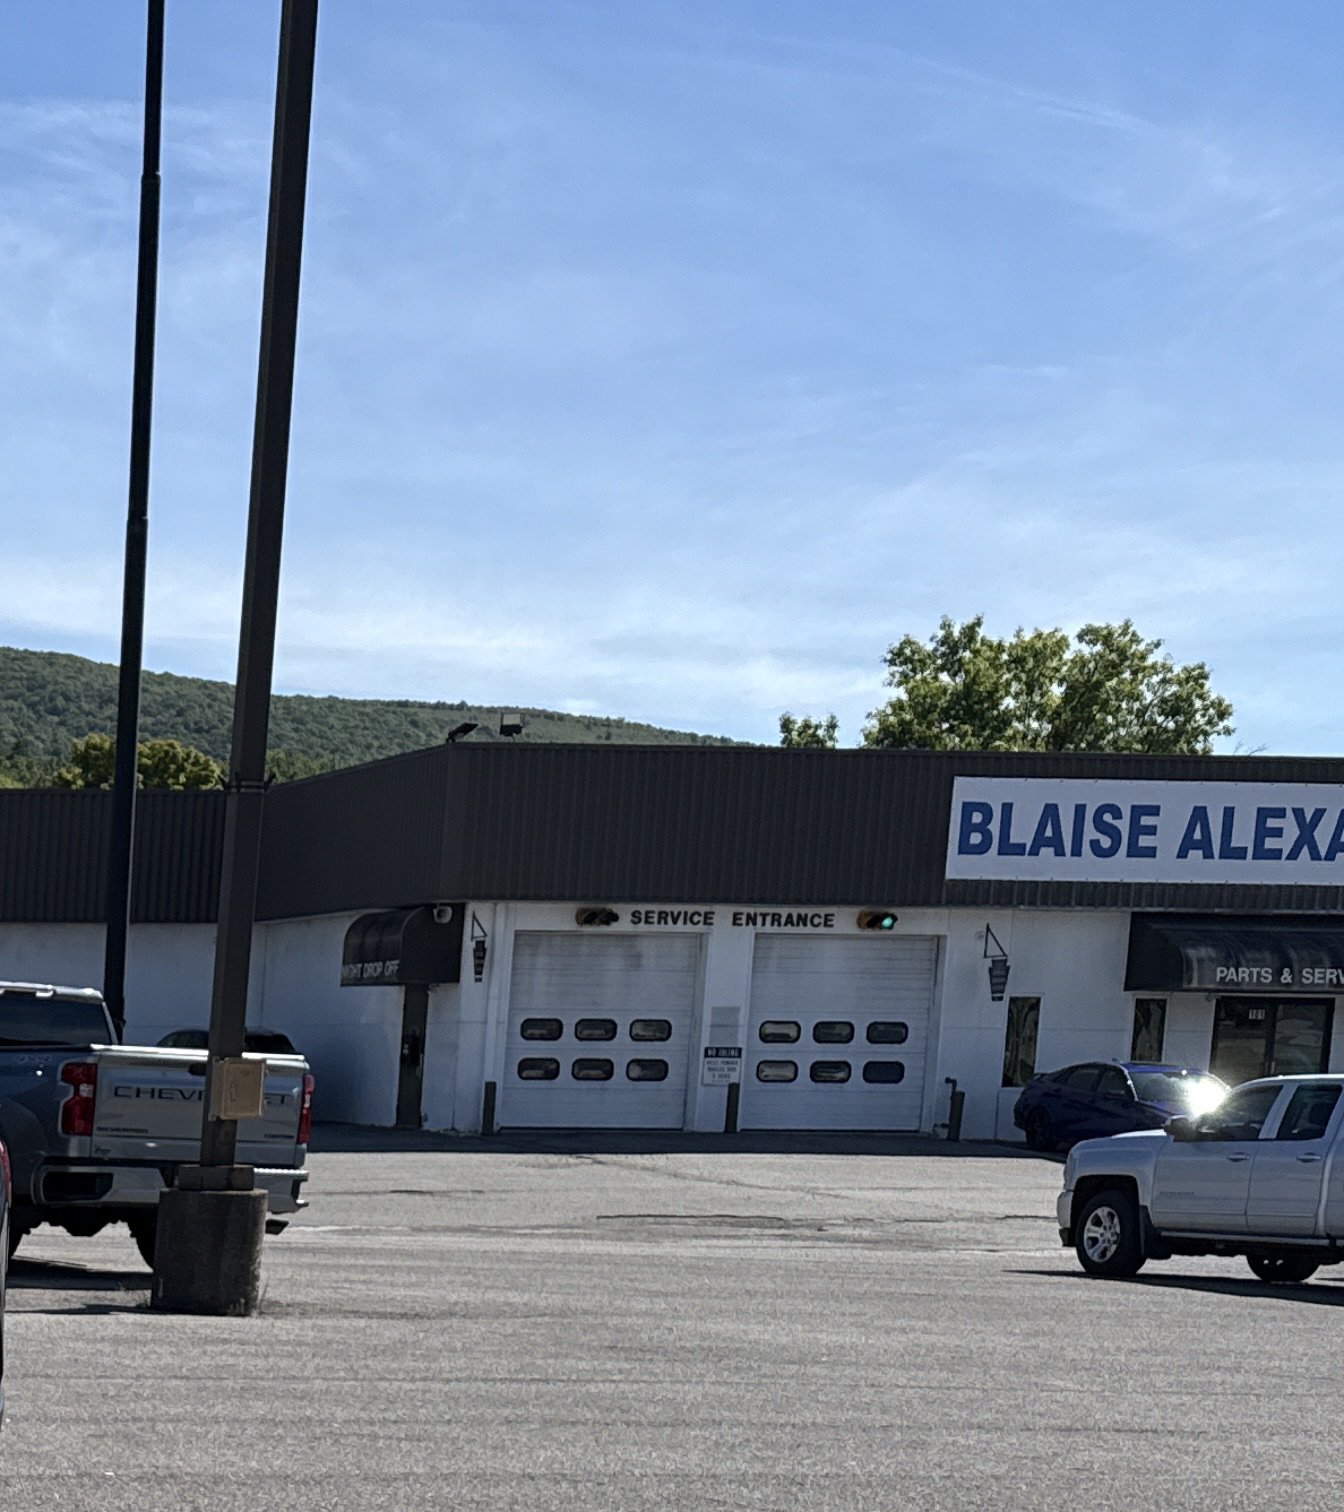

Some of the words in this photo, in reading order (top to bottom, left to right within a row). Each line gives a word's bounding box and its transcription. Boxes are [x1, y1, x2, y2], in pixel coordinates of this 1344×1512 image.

[957, 801, 1161, 858] BLAISE
[630, 910, 715, 927] SERVICE
[732, 912, 835, 928] ENTRANCE
[363, 961, 383, 978] DROP
[384, 959, 400, 976] OFF
[1216, 967, 1272, 983] PARTS
[1280, 968, 1293, 983] &
